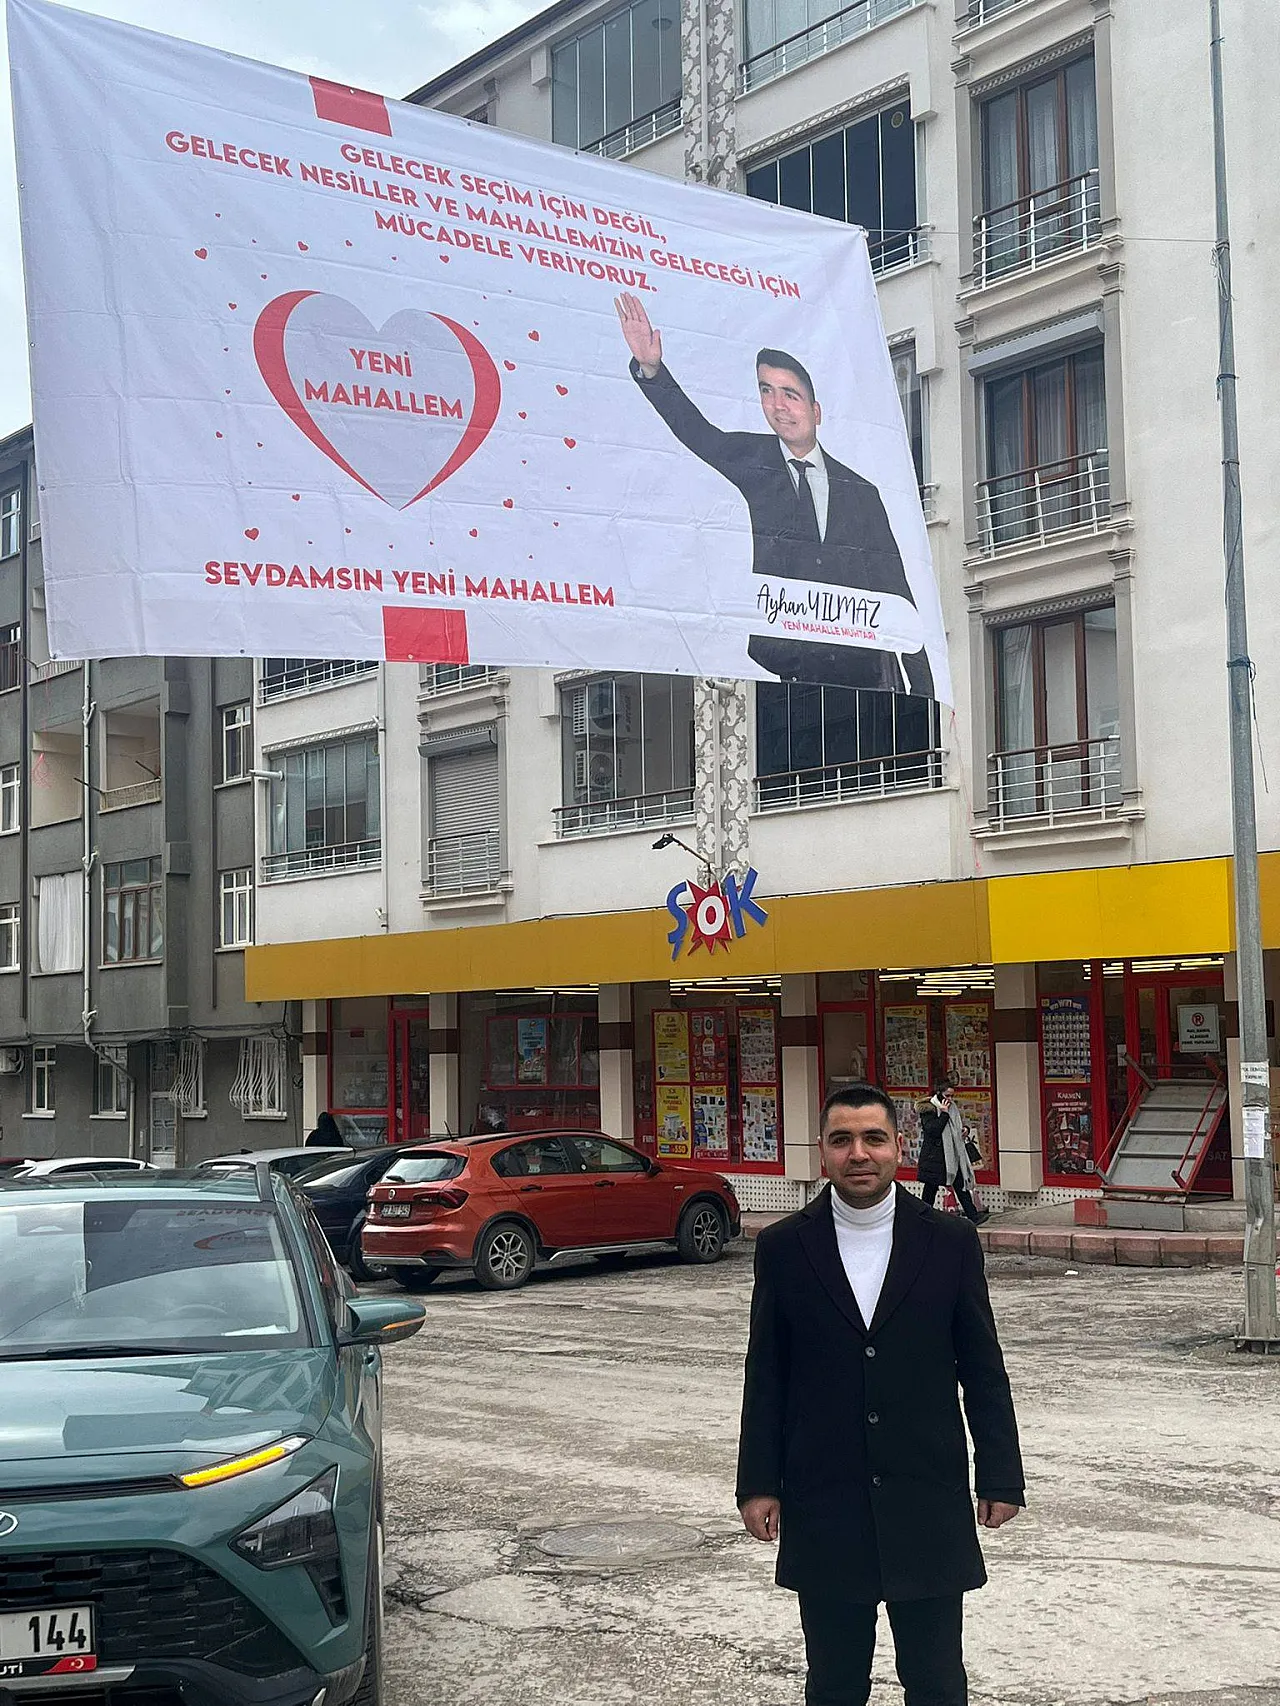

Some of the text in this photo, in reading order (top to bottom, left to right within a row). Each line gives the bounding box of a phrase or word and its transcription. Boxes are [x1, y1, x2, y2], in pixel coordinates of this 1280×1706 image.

[165, 131, 801, 300] GELECEK NESİLLER VE MAHALLEMİZİN GELECEĞİ İÇİN
[340, 143, 669, 245] GELECEK SEÇİM İÇİN DEĞİL,
[375, 209, 659, 293] MÜCADELE VERİYORUZ.
[349, 348, 413, 378] YENİ
[304, 378, 464, 420] MAHALLEM
[204, 560, 616, 608] SEVDAMSIN YENİ MAHALLEM
[757, 583, 881, 629] Ayhan YILMAZ
[781, 620, 876, 641] YENİ MAHALLE MUHTARI
[27, 1612, 87, 1653] 144
